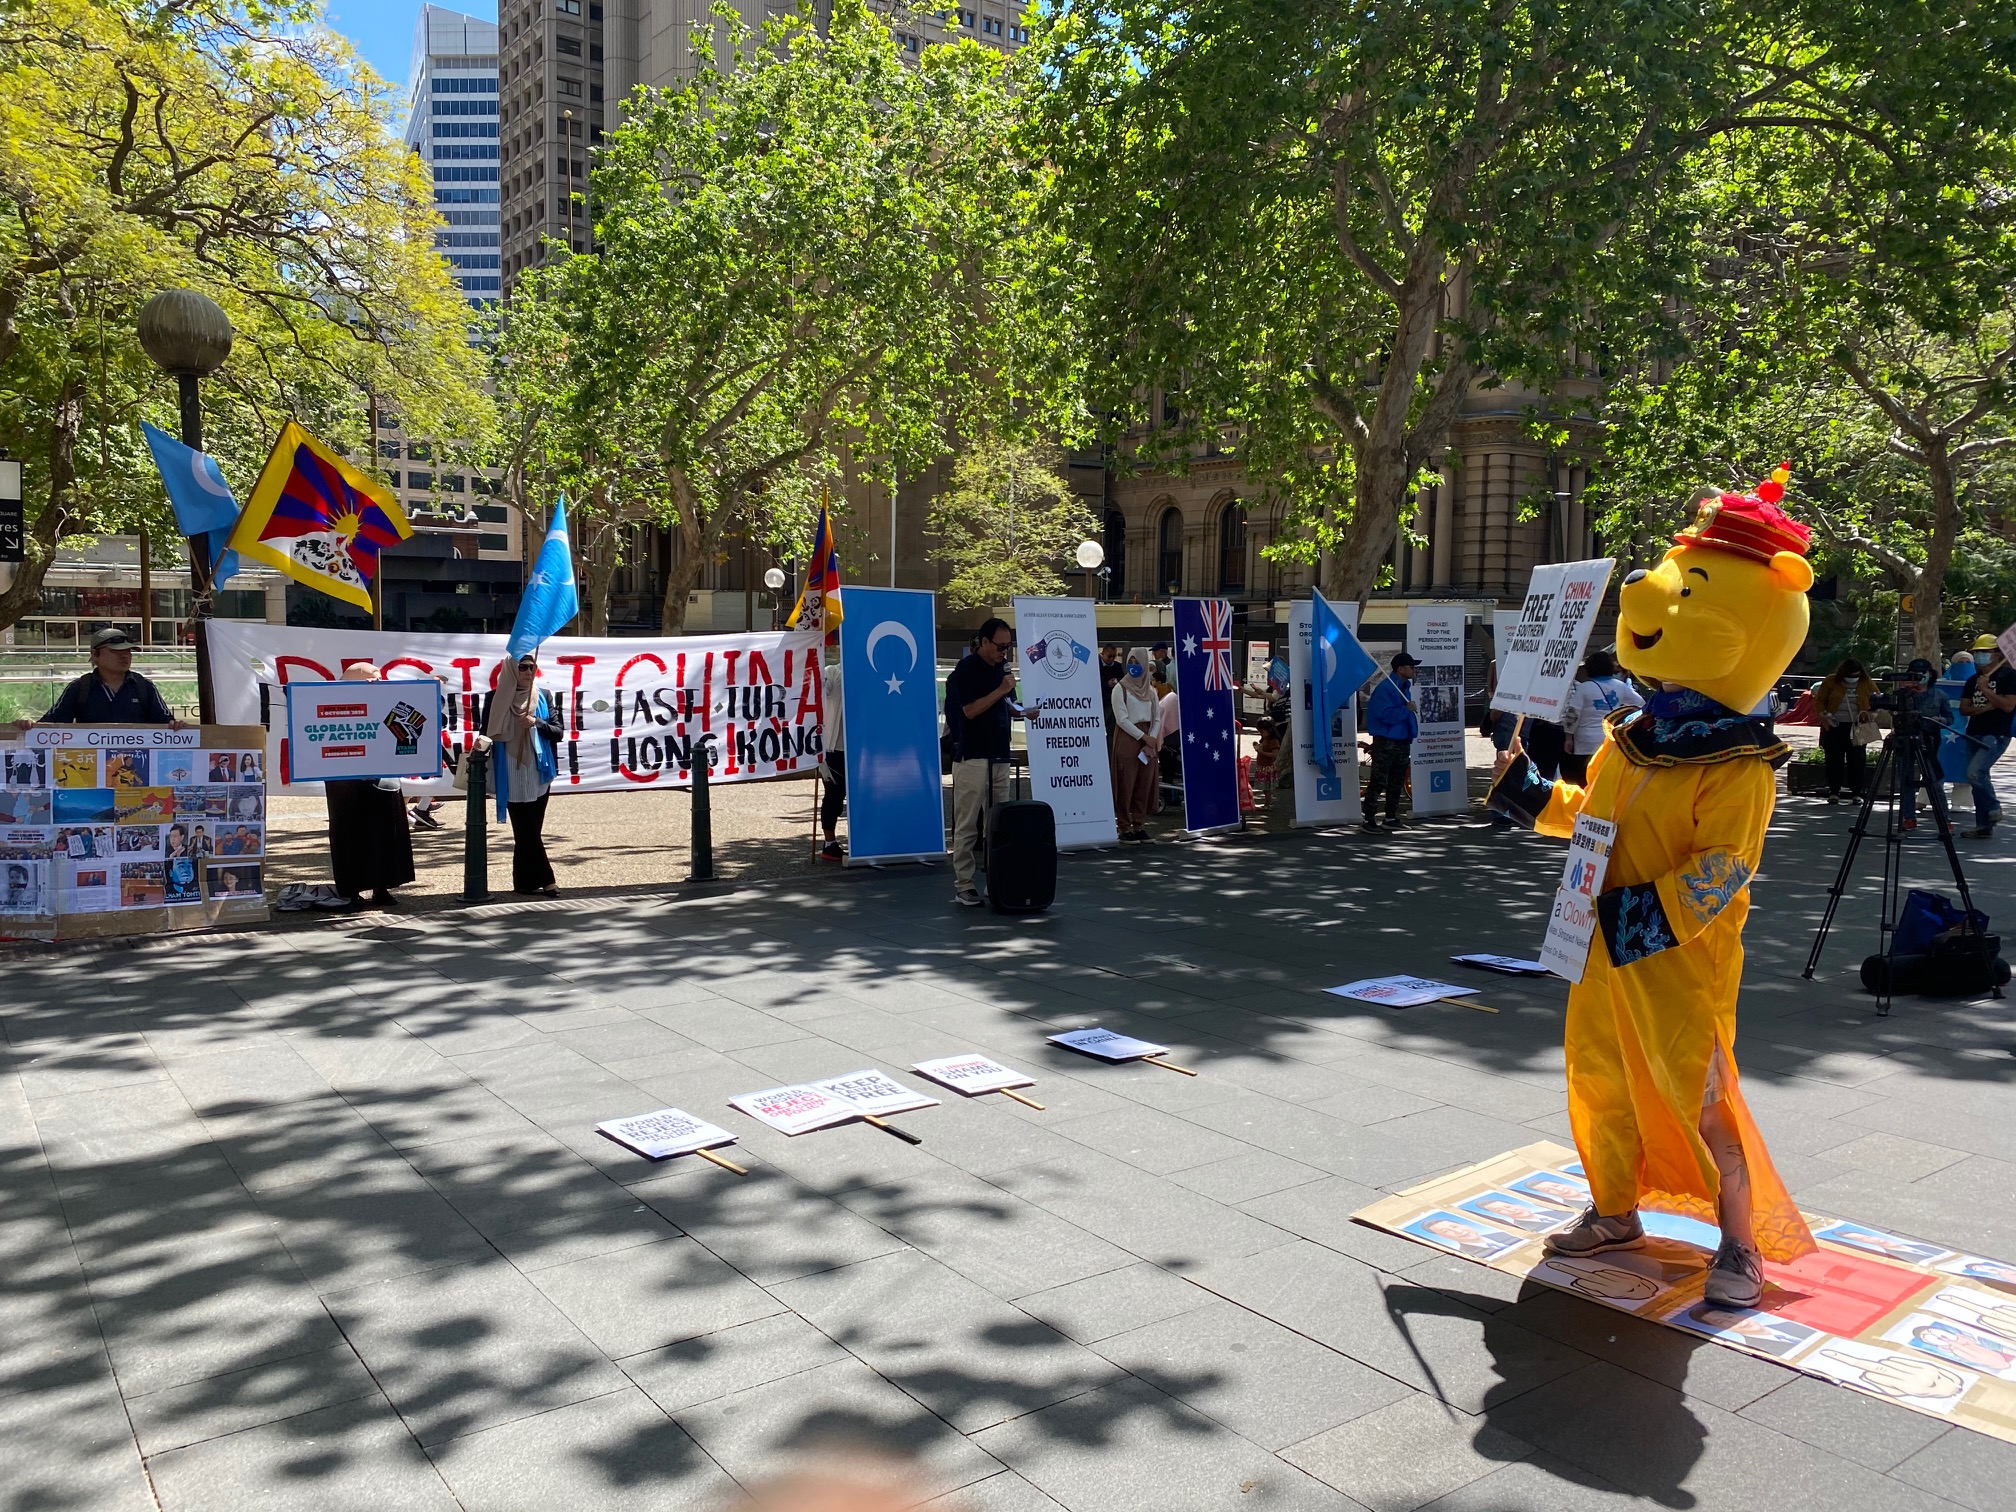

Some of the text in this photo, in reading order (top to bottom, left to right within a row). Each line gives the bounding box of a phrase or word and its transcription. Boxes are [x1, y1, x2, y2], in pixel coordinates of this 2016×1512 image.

[1522, 594, 1555, 622] FREE
[1560, 601, 1589, 619] CLOSE
[1516, 624, 1546, 637] SOUTHERN
[1559, 621, 1577, 638] THE
[1511, 639, 1540, 652] MONGOLIA
[1544, 640, 1578, 658] UYGHUR
[1540, 659, 1568, 678] CAMPS
[1036, 698, 1092, 710] DEMOCRACY
[614, 648, 824, 783] CHINA
[1032, 716, 1100, 729] HUMAN RIGHTS
[304, 722, 380, 733] GLOBAL DAY
[36, 732, 193, 745] CCP Crimes Show
[308, 732, 376, 741] OF ACTION
[1046, 736, 1090, 749] FREEDOM
[610, 733, 720, 772] HONG
[736, 723, 824, 764] KONG
[1060, 756, 1079, 768] FOR
[1050, 774, 1093, 788] UYGHURS
[1555, 900, 1593, 930] a Clown
[939, 1064, 992, 1076] SHAME
[973, 1067, 1003, 1076] YOU
[824, 1076, 881, 1091] KEEP
[834, 1082, 894, 1098] TAIWAN
[754, 1090, 801, 1103] WORLD
[846, 1087, 906, 1101] FREE
[760, 1093, 823, 1114] REJECT
[784, 1103, 826, 1118] POLICY
[620, 1114, 672, 1128] WORLD
[627, 1120, 695, 1138] REJECT
[651, 1130, 696, 1142] POLICY
